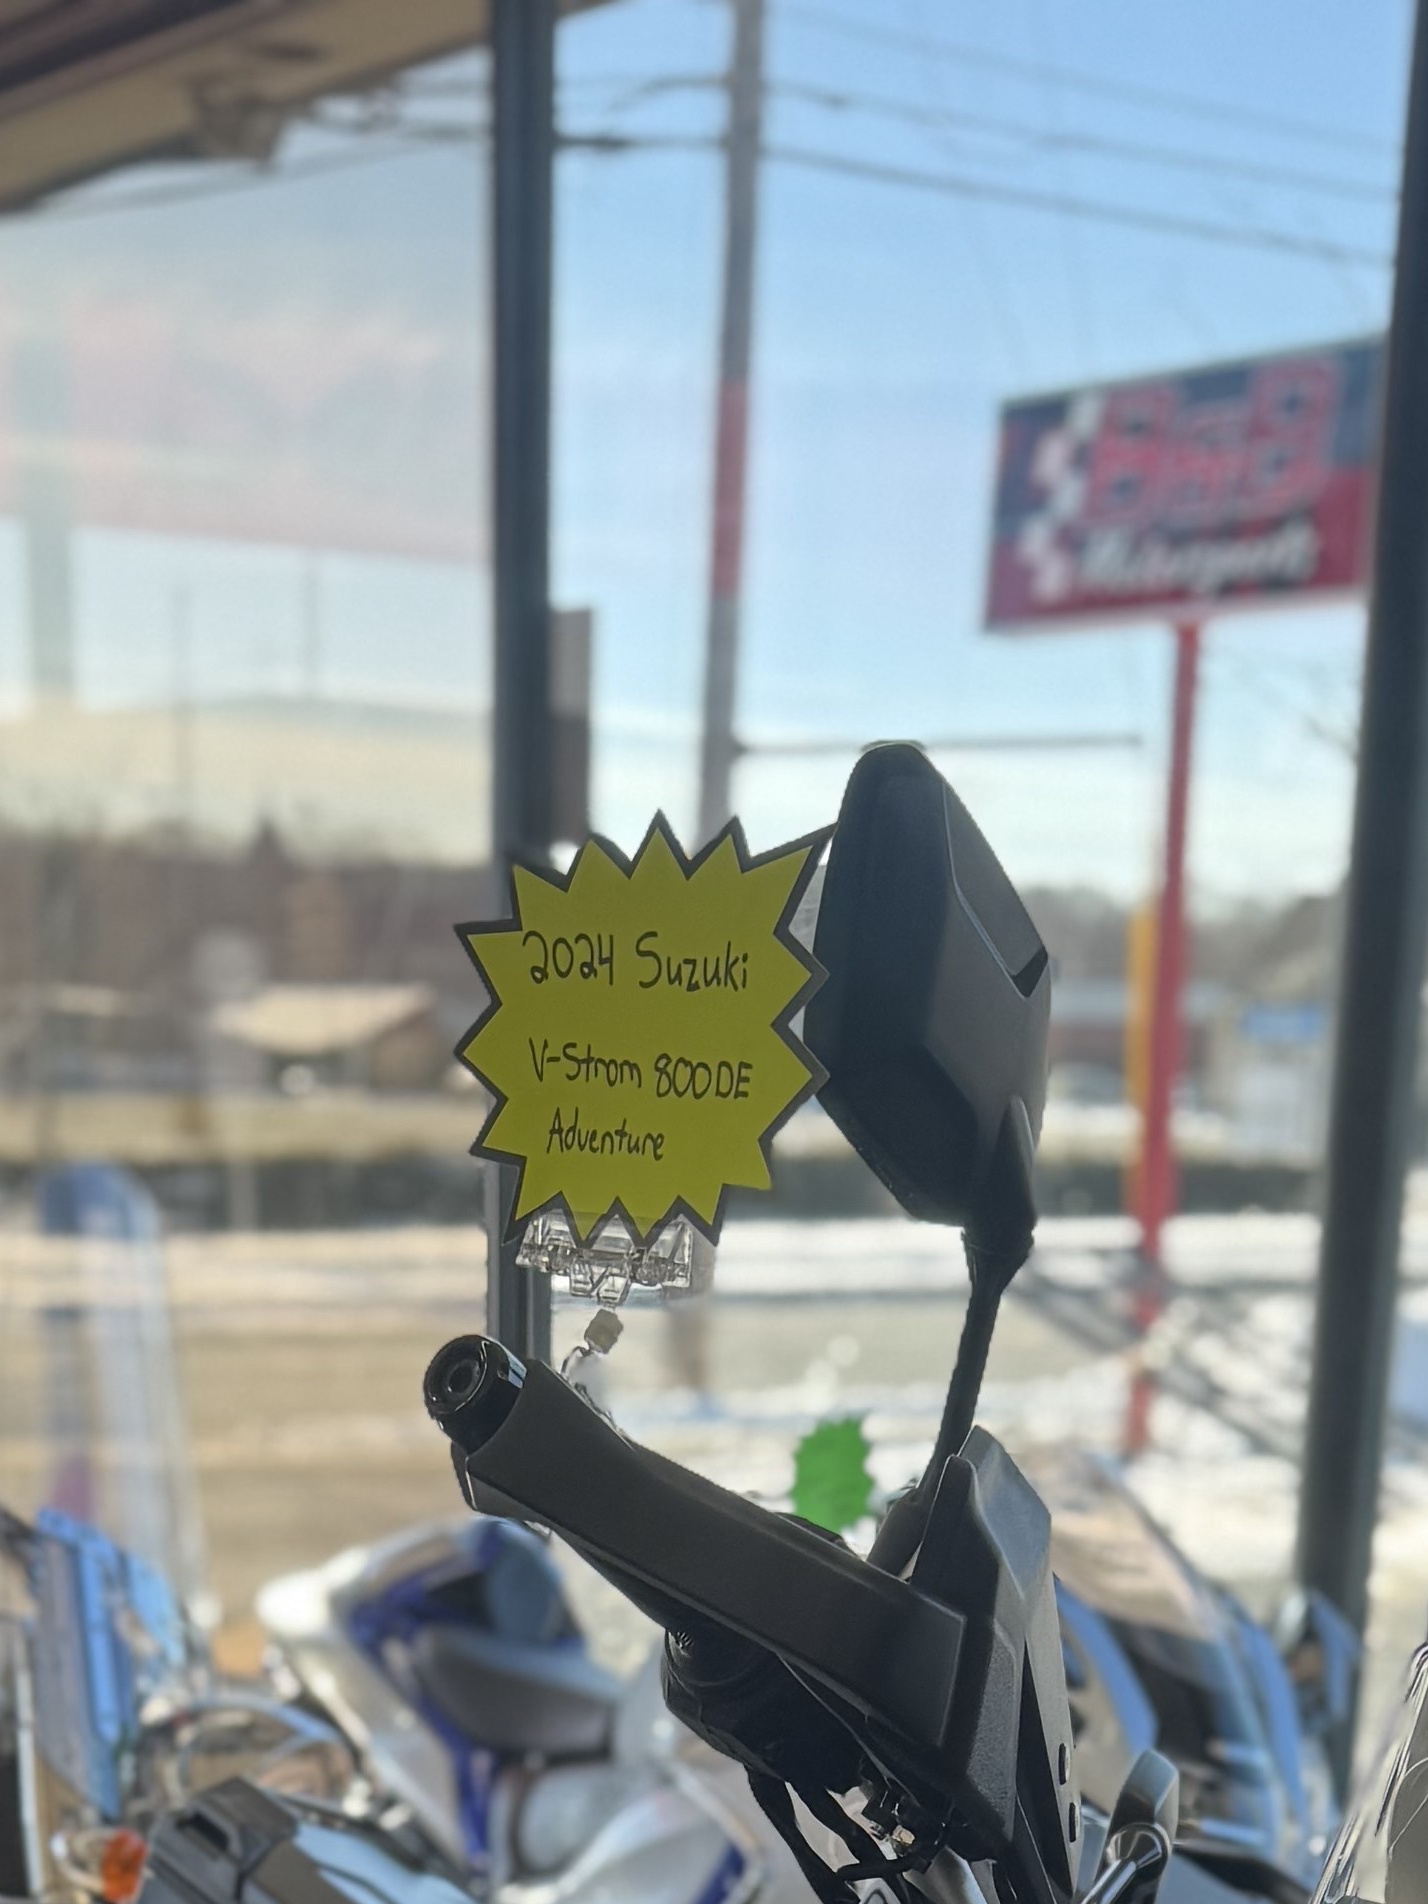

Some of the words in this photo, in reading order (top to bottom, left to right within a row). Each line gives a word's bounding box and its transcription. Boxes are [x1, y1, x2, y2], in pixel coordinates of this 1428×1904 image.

[523, 930, 615, 985] 2024
[635, 931, 749, 991] Suzuki
[528, 1037, 642, 1089] V-Strom
[654, 1053, 753, 1099] 800DE
[546, 1106, 665, 1161] Adventure
